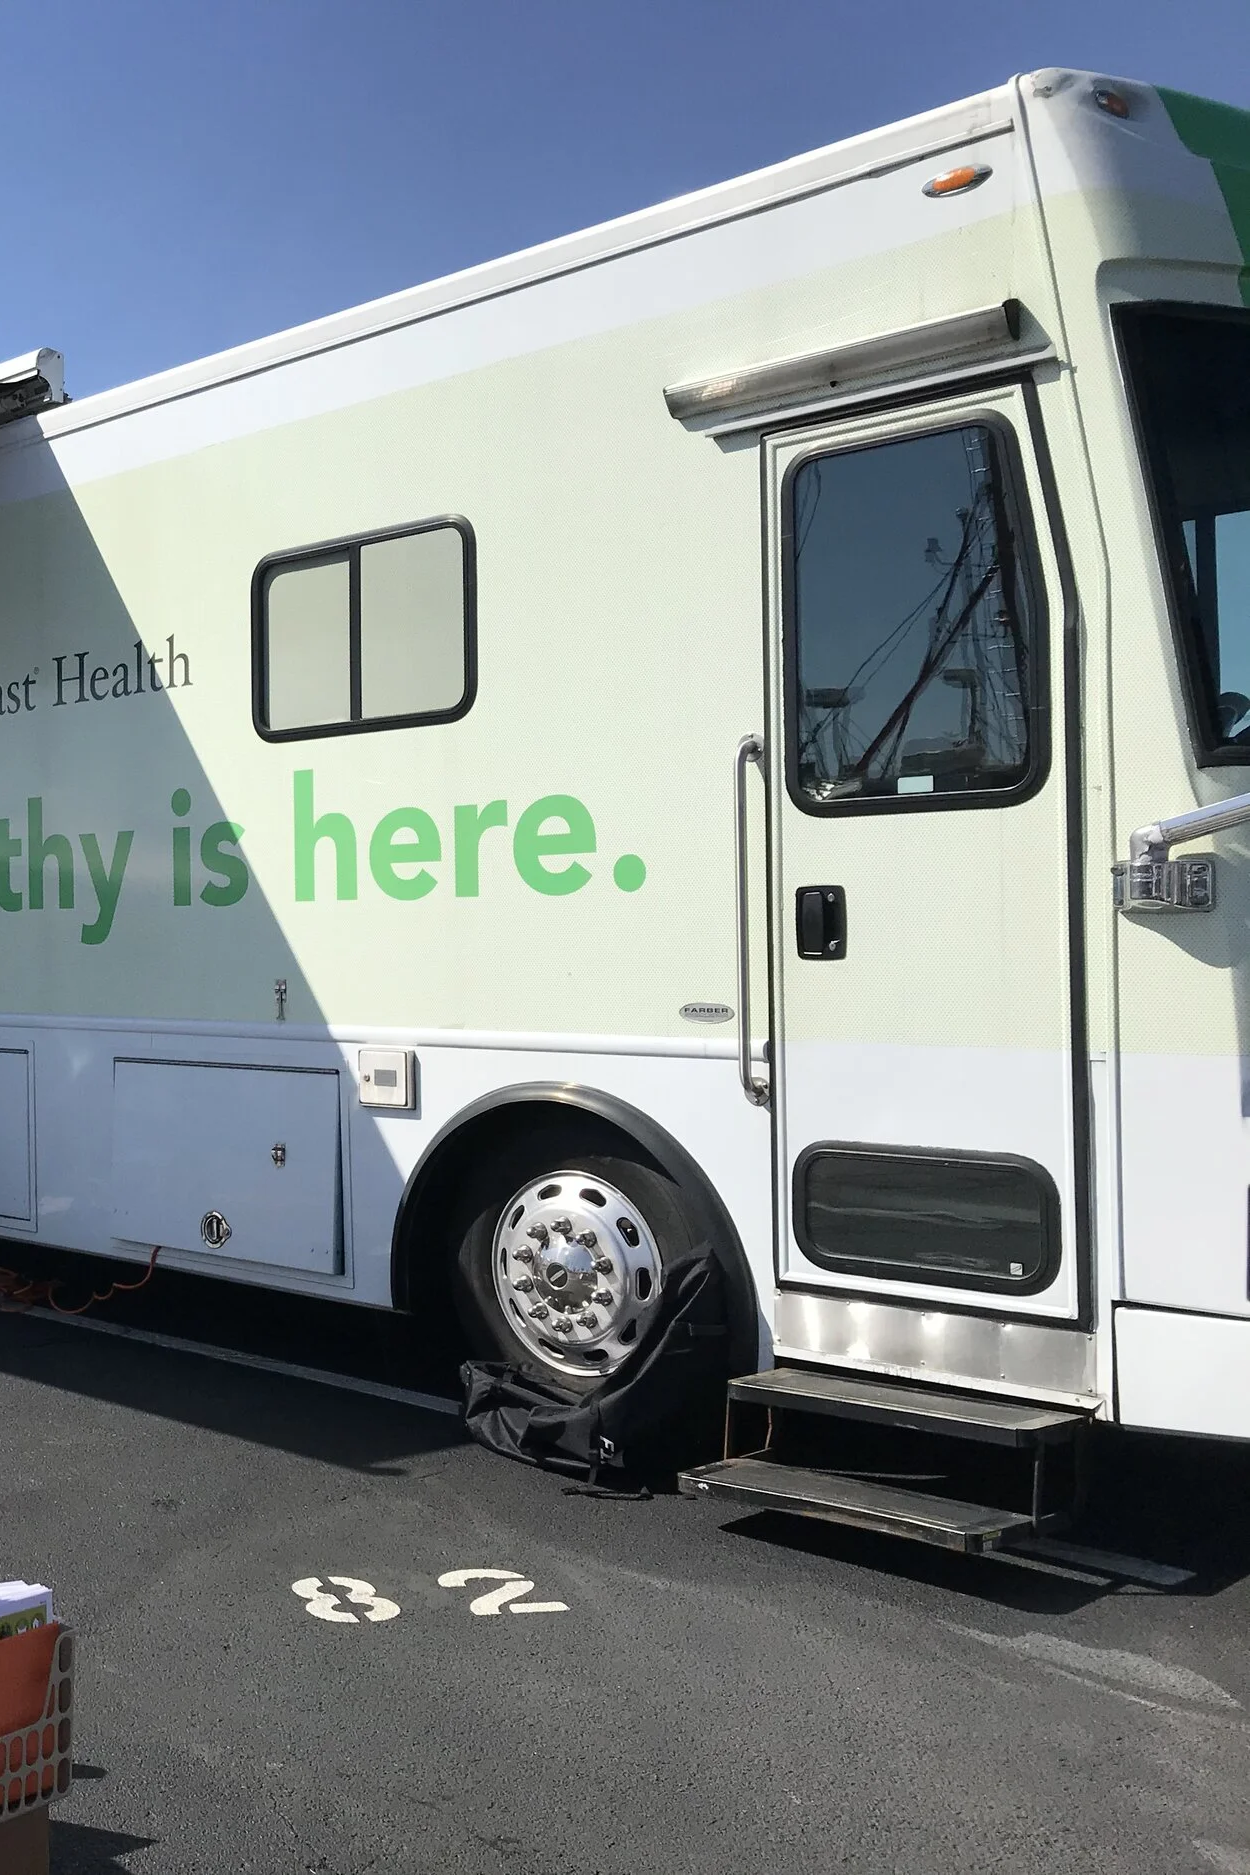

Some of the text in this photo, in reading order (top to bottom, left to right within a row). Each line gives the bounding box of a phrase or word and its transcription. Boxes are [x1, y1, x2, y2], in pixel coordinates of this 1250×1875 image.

[52, 633, 193, 707] Health
[170, 788, 249, 907] is
[293, 769, 646, 902] here.
[291, 1568, 571, 1623] 82
